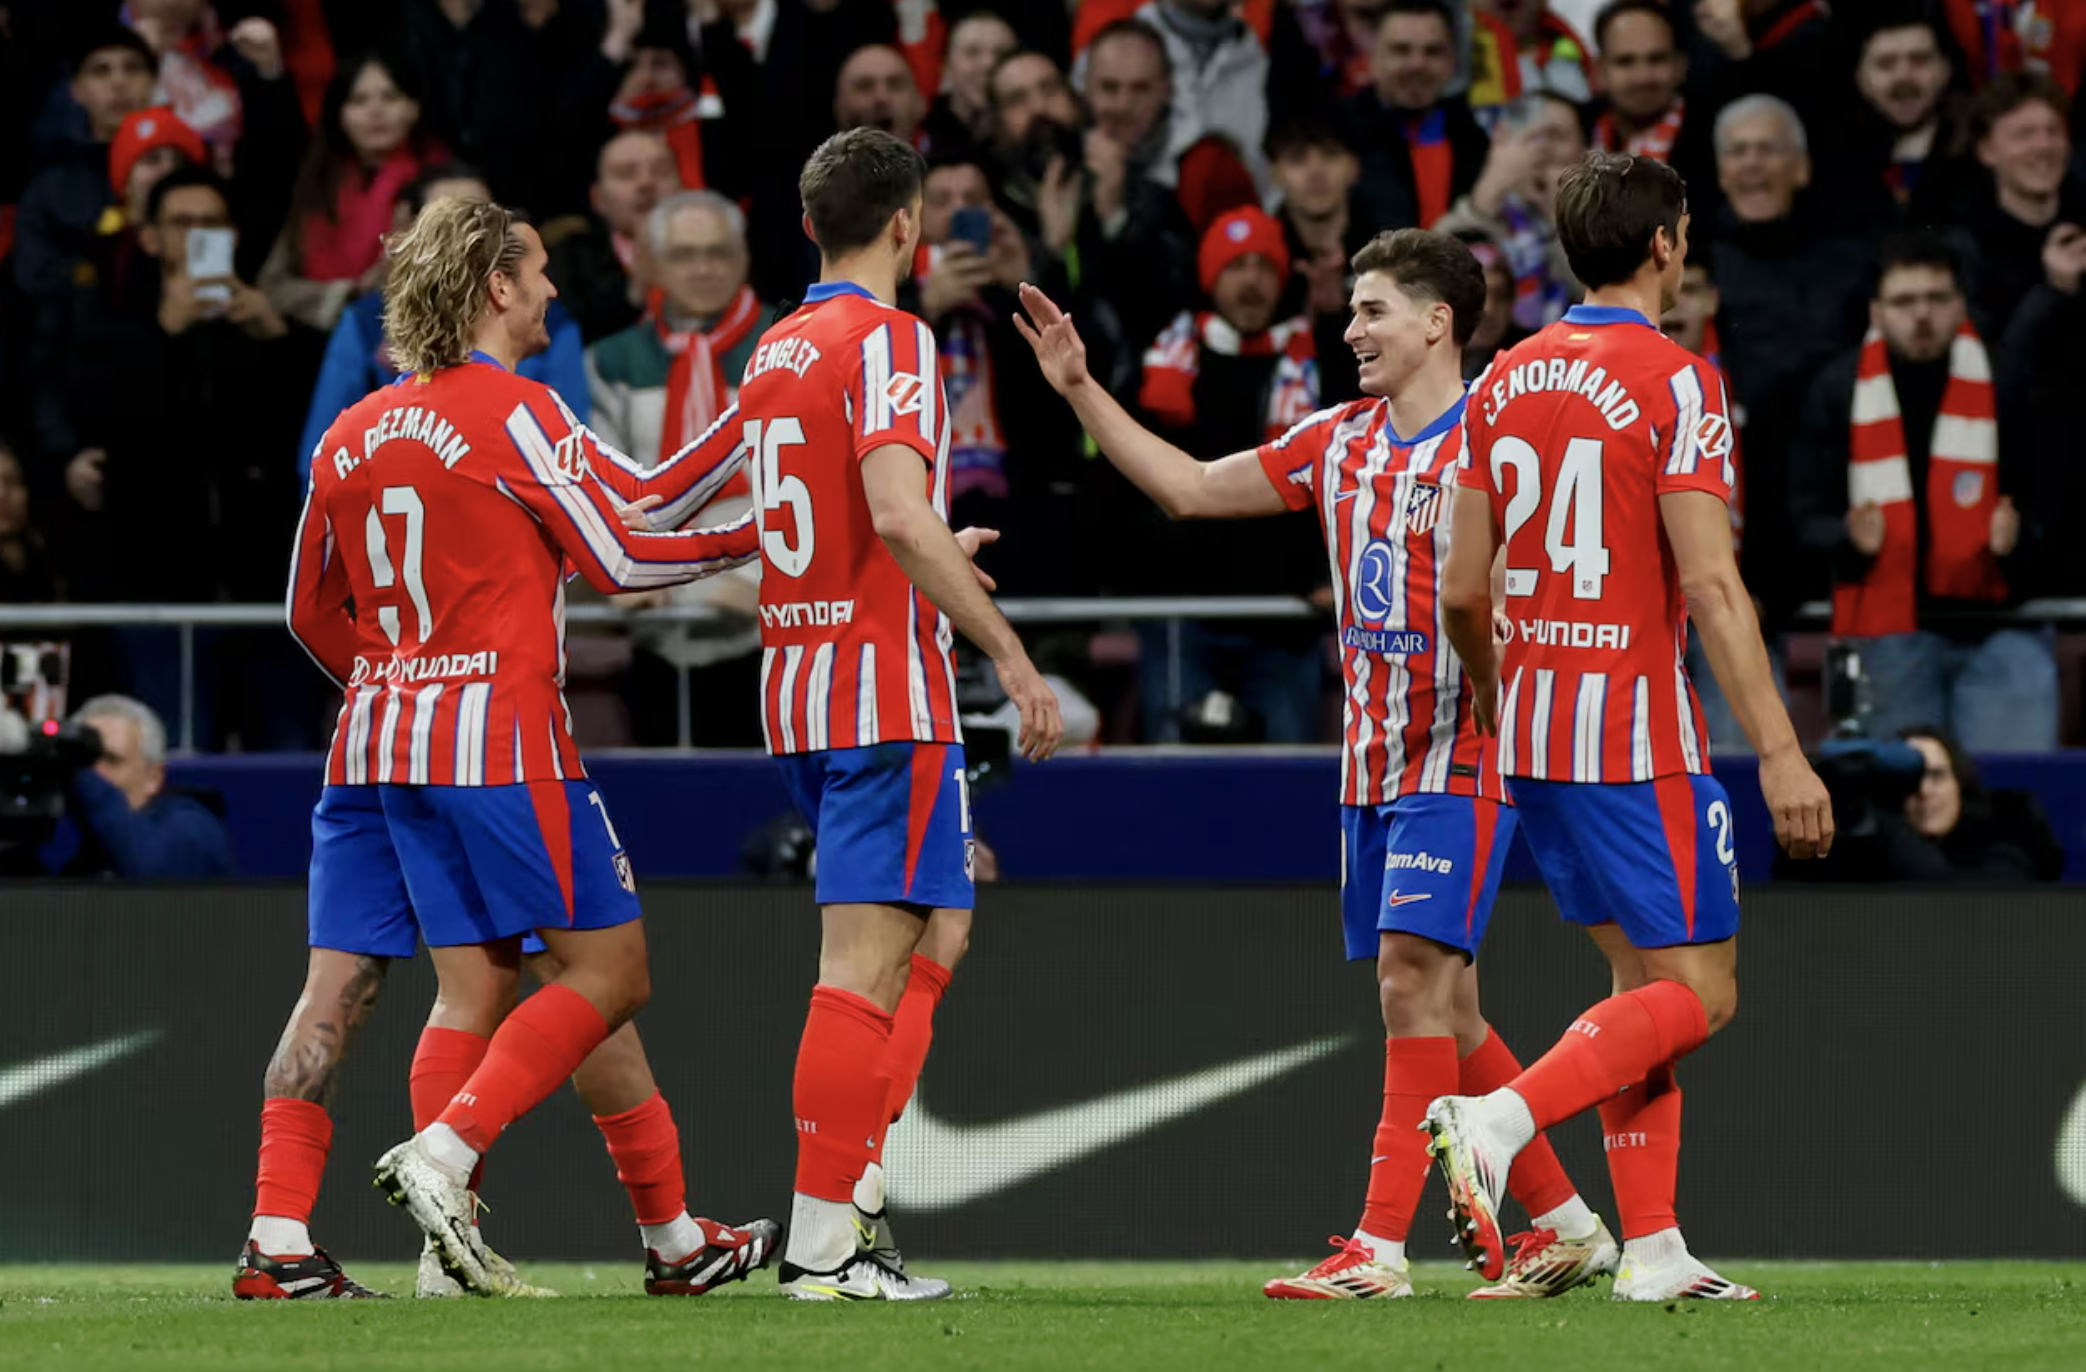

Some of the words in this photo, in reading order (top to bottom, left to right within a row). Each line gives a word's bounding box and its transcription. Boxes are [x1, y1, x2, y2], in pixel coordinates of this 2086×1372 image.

[743, 416, 815, 578] 15
[1490, 434, 1610, 600] 24
[1390, 634, 1424, 652] AIR
